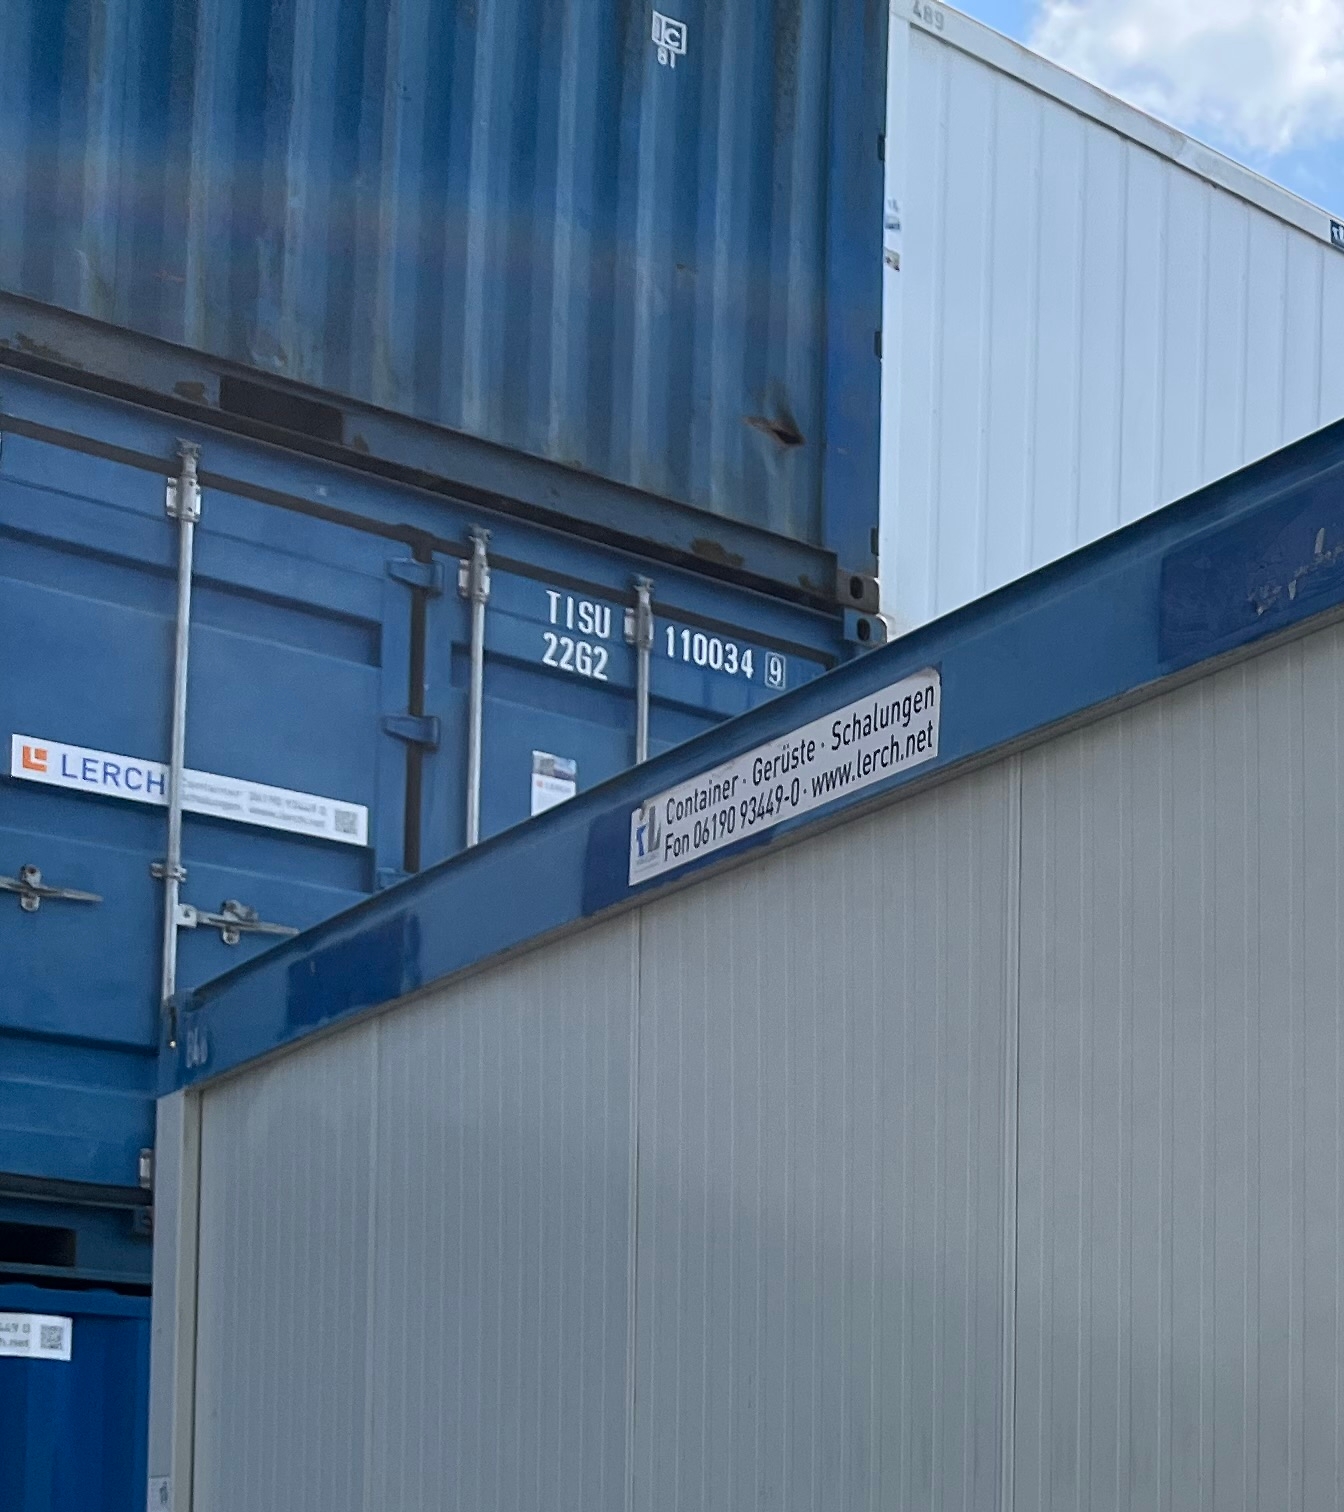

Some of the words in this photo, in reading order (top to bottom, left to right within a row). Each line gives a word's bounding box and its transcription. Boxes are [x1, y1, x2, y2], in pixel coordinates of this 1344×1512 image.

[541, 631, 608, 681] 22G2
[545, 589, 611, 639] TISU
[665, 625, 754, 679] 110034
[768, 654, 783, 687] 9
[61, 752, 165, 796] LERCH
[664, 831, 690, 861] Fon
[693, 809, 736, 849] 06190
[740, 777, 800, 829] 93449-0
[811, 720, 933, 797] www.lerch.net
[666, 774, 739, 825] Container
[752, 739, 815, 787] Gerüste
[831, 684, 935, 751] Schalungen
